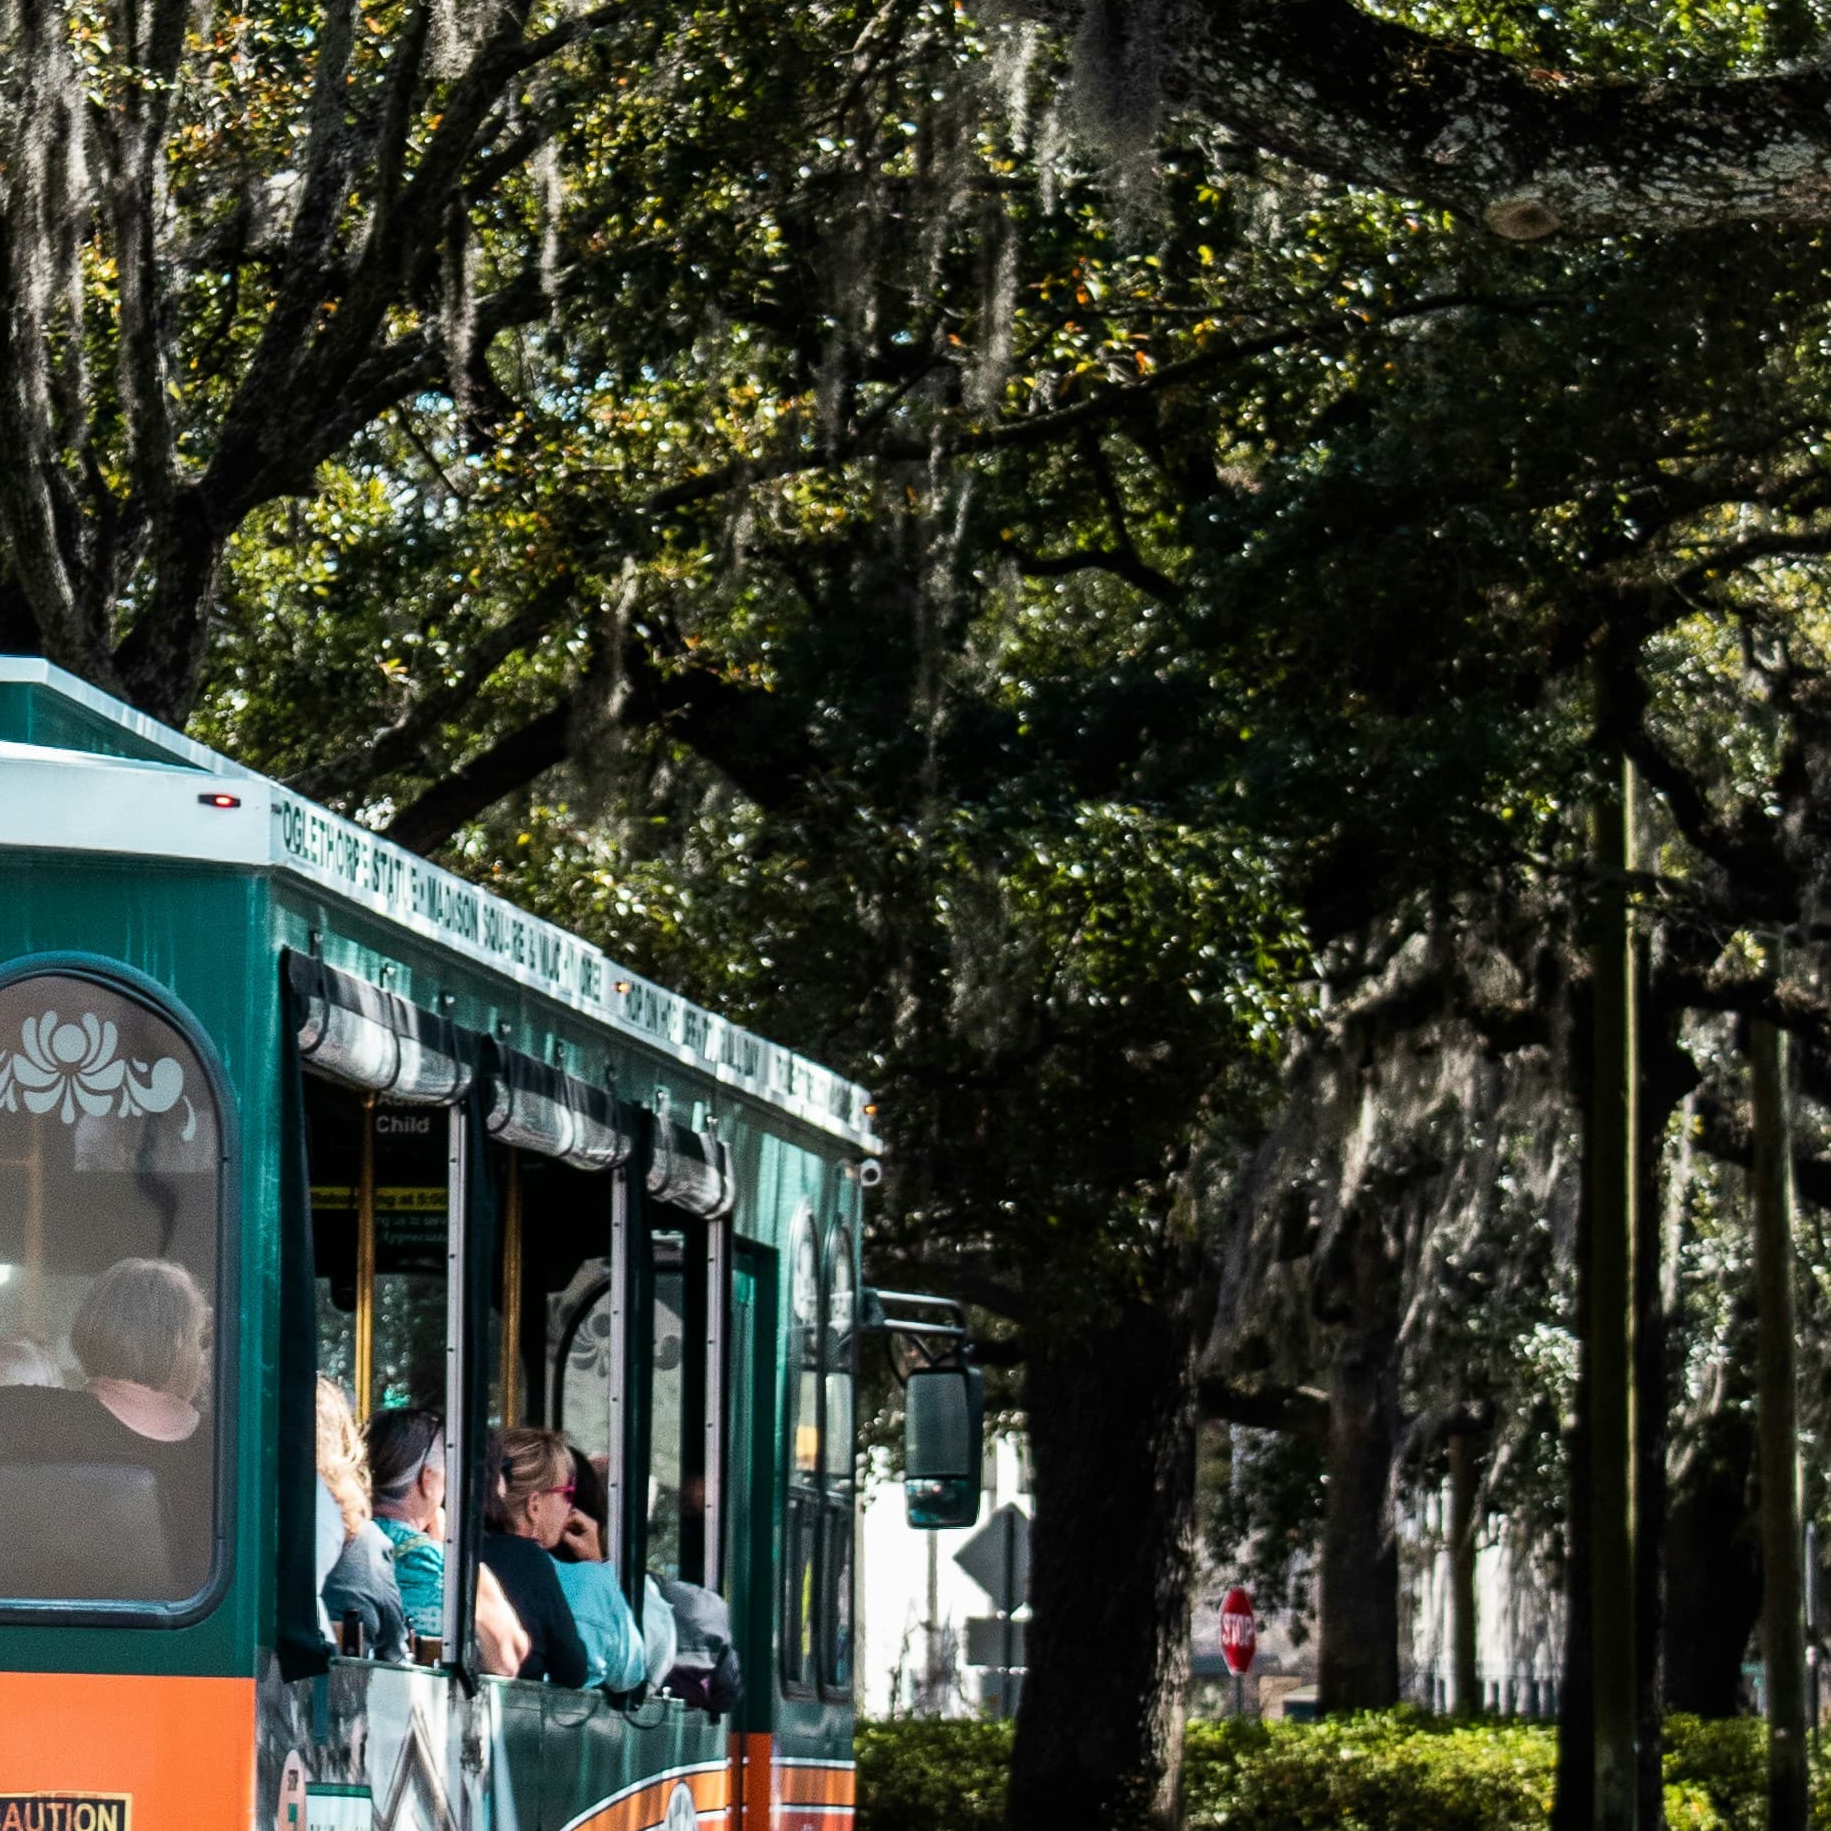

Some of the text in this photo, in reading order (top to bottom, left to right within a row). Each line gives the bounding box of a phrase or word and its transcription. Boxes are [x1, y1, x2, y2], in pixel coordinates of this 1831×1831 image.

[282, 800, 369, 889] OGLETHORPE
[375, 1114, 430, 1134] Child
[1222, 1612, 1254, 1647] STOP
